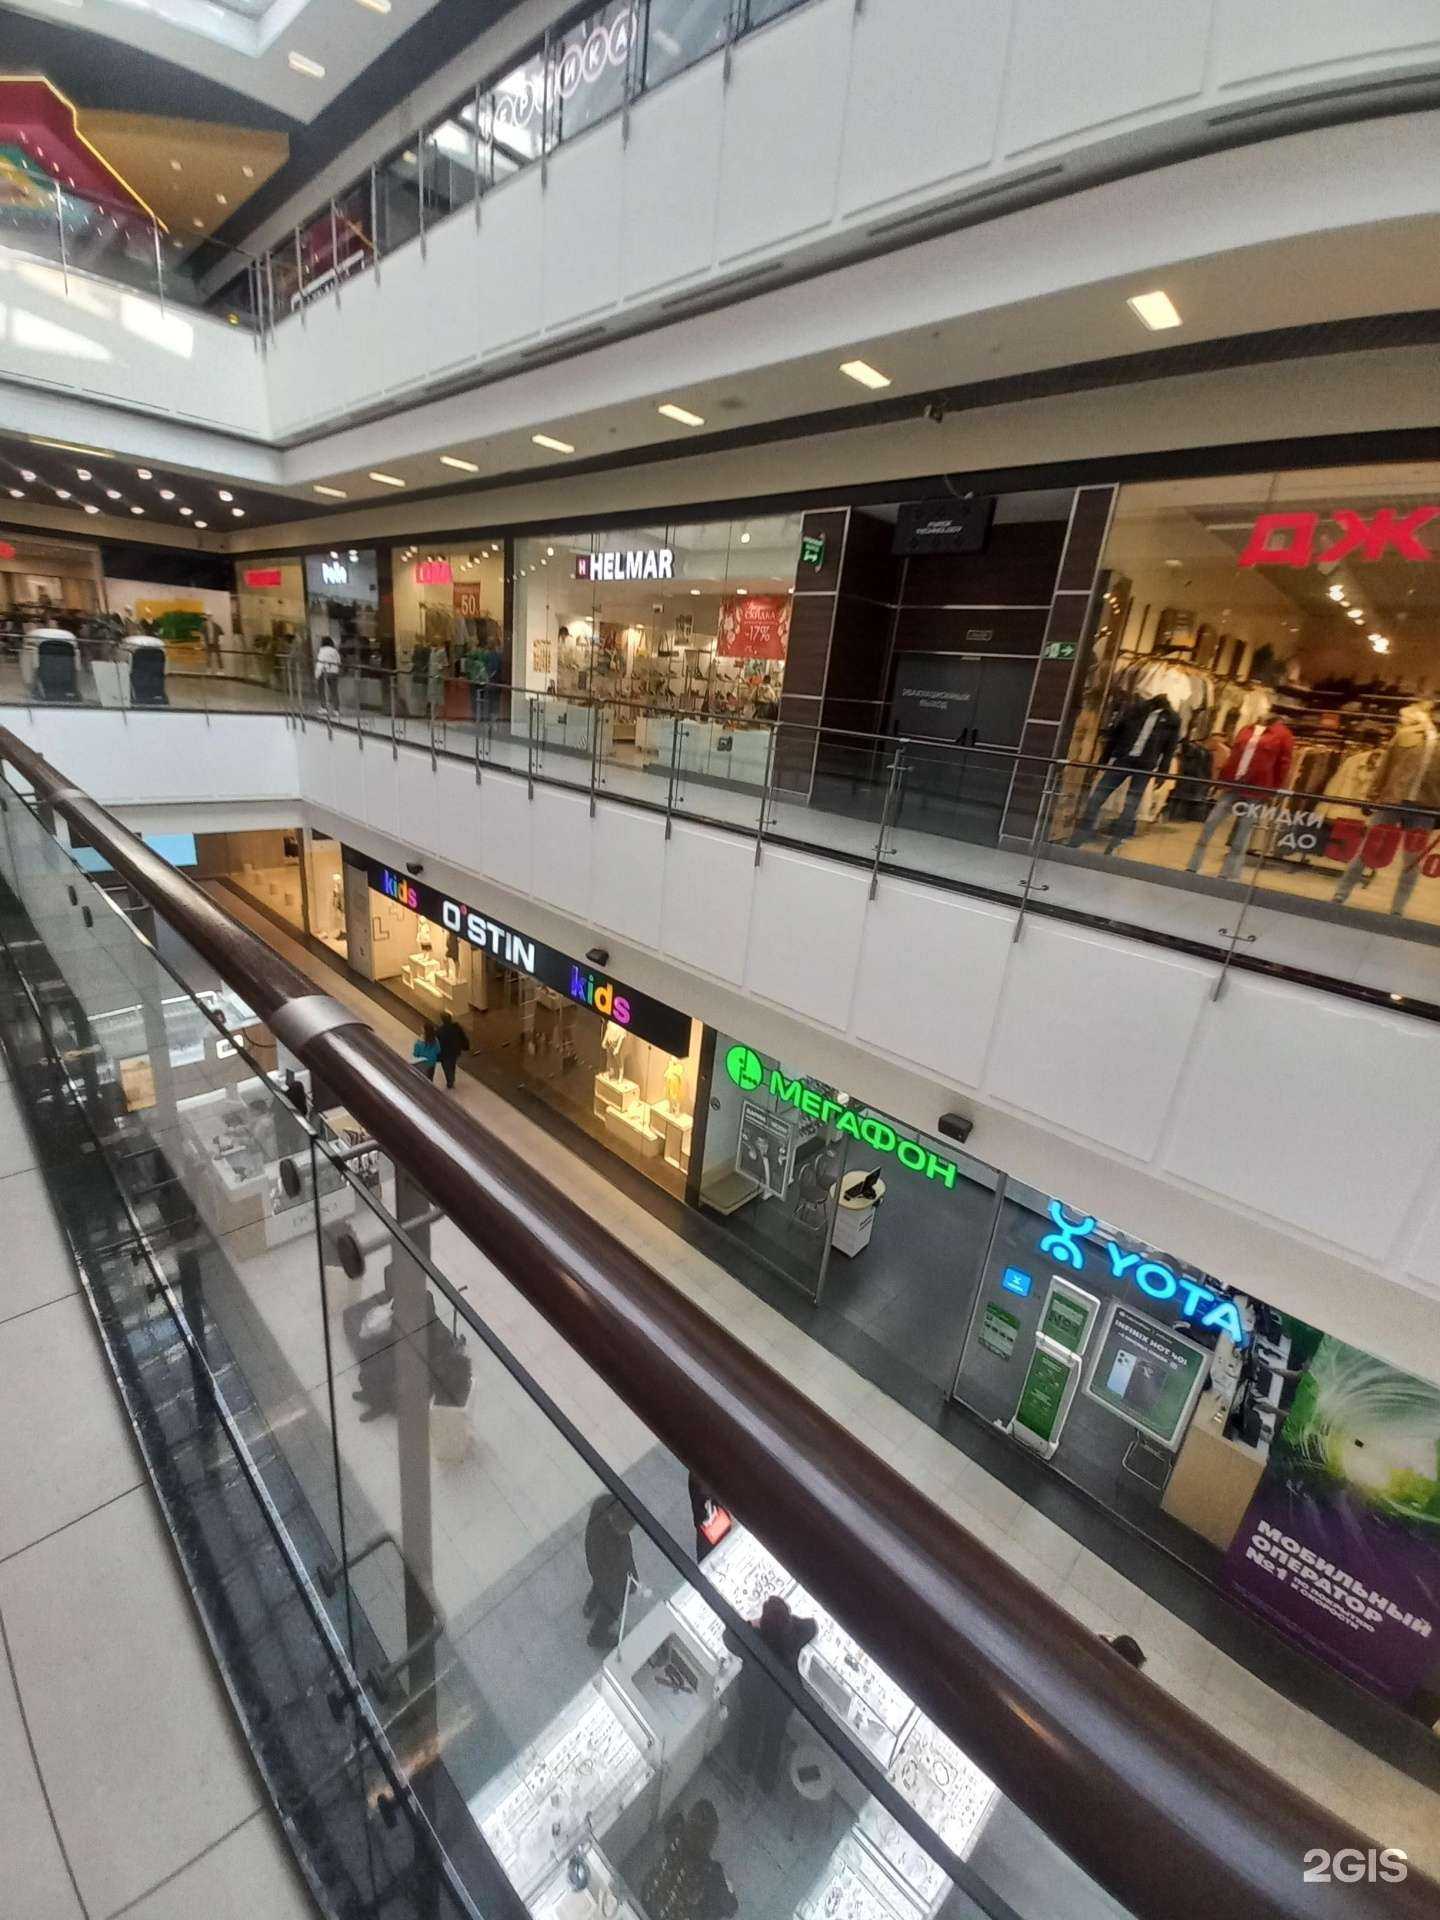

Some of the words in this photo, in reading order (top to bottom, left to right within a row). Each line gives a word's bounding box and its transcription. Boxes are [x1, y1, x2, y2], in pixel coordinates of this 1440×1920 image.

[589, 548, 674, 581] HELMAR
[1232, 801, 1324, 829] СКИДКИ
[1278, 832, 1316, 849] ДО
[384, 869, 418, 909] kids
[442, 899, 536, 974] O'STIN
[570, 965, 632, 1025] kids
[769, 1070, 958, 1189] МЕГАФОН
[1104, 1241, 1245, 1344] YOTA
[1251, 1534, 1384, 1622] ОПЕРАТОР
[1257, 1519, 1433, 1638] МОБИЛЬНЫЙ
